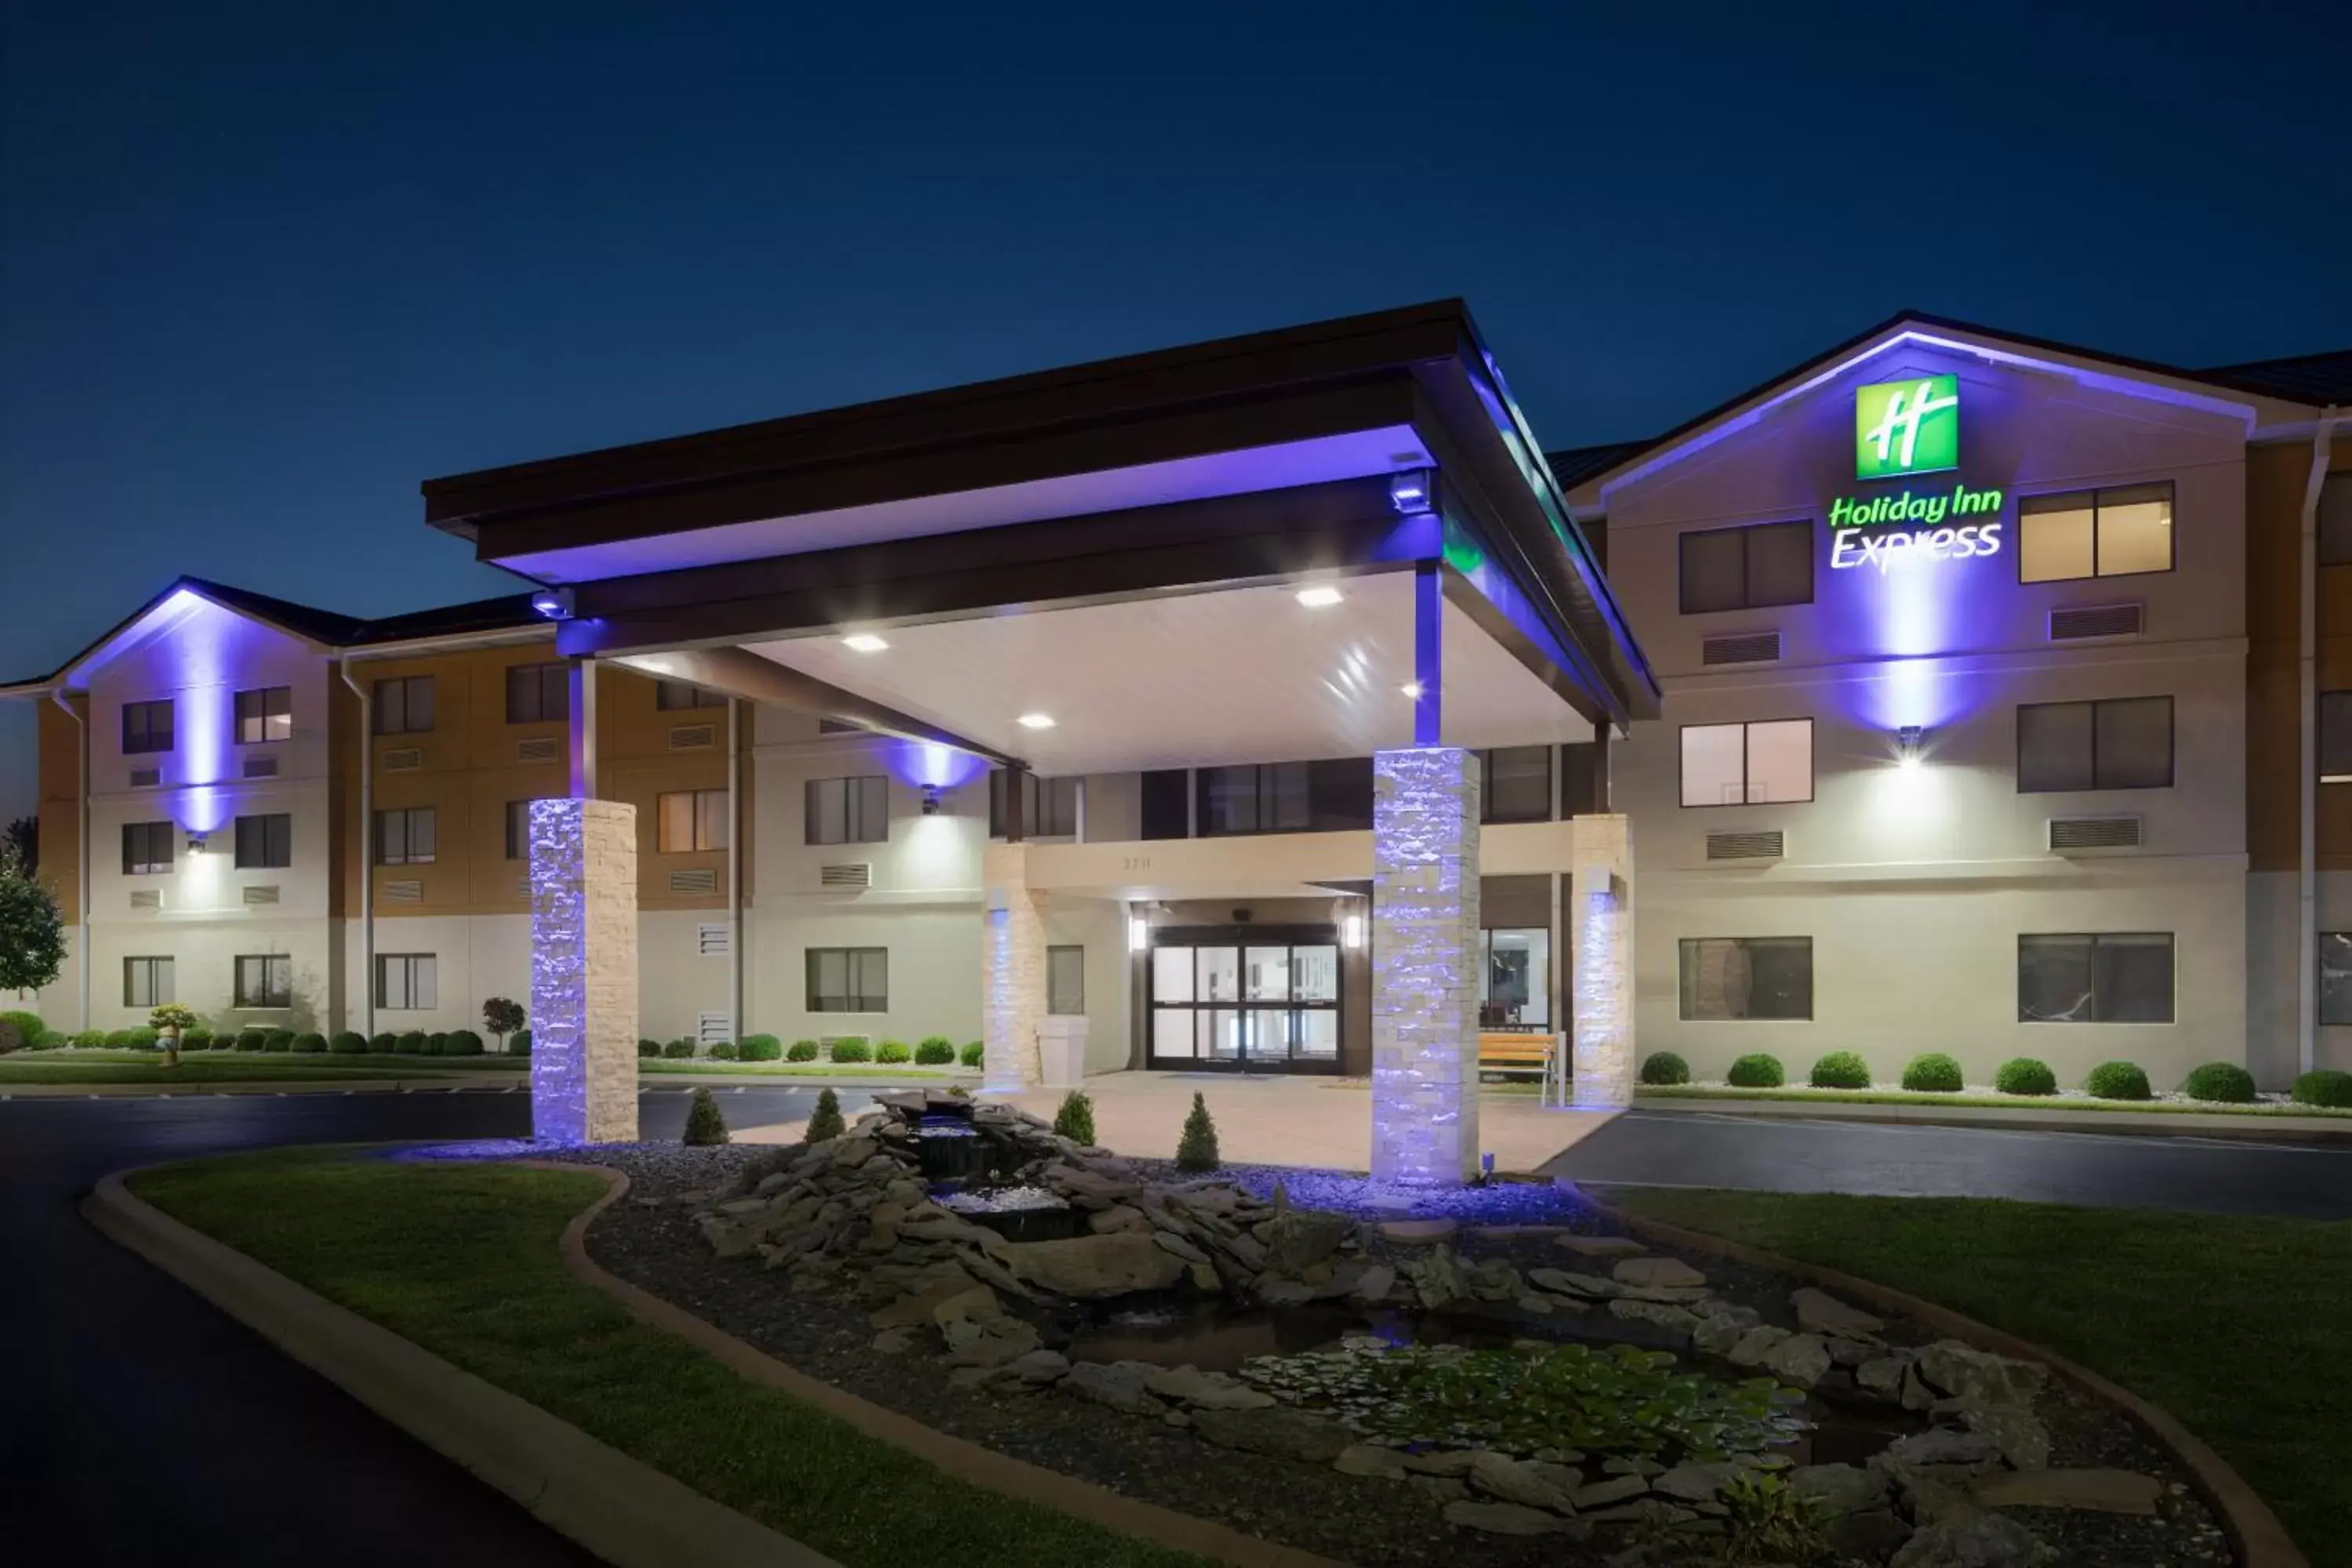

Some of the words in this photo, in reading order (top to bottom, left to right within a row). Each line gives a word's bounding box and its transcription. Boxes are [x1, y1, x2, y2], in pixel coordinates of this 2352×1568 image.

[1829, 491, 1948, 527] Holiday
[1952, 485, 2002, 514] Inn
[1830, 523, 2002, 575] Express
